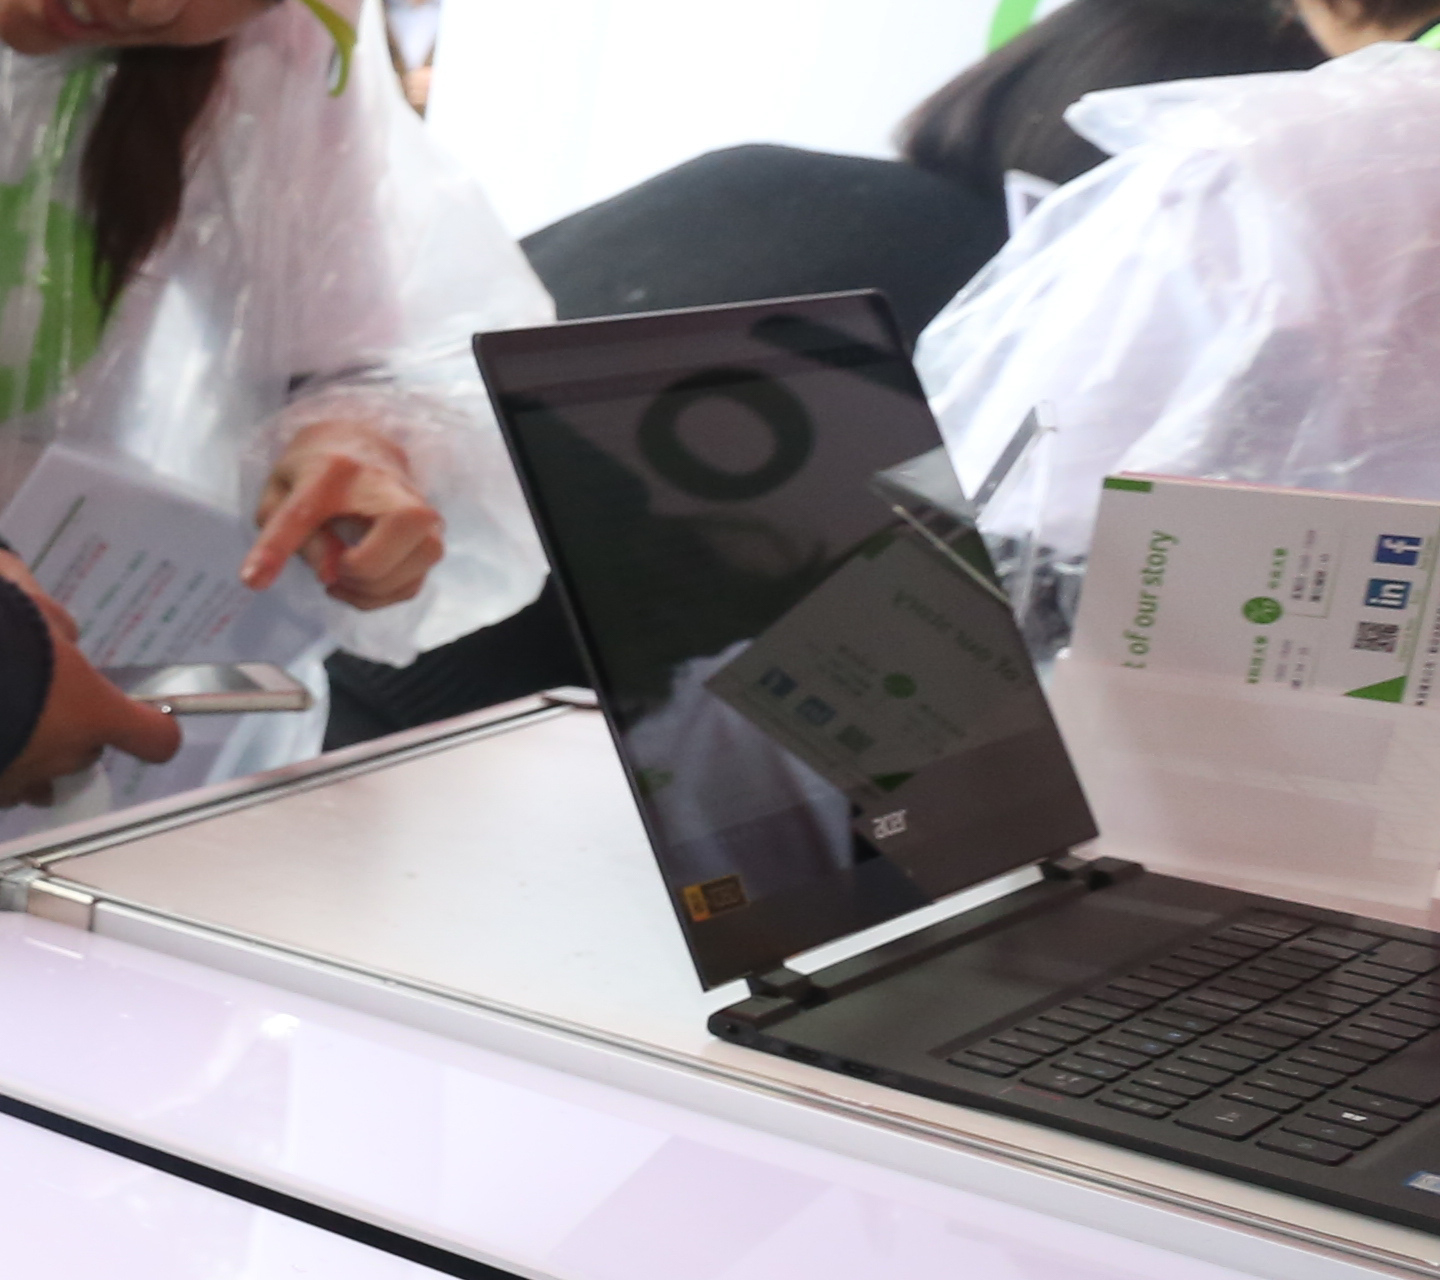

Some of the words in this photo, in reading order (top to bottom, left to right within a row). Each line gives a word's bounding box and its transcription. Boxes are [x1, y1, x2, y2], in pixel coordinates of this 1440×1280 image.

[1139, 530, 1178, 586] story
[1133, 590, 1157, 628] our
[871, 807, 907, 839] acer
